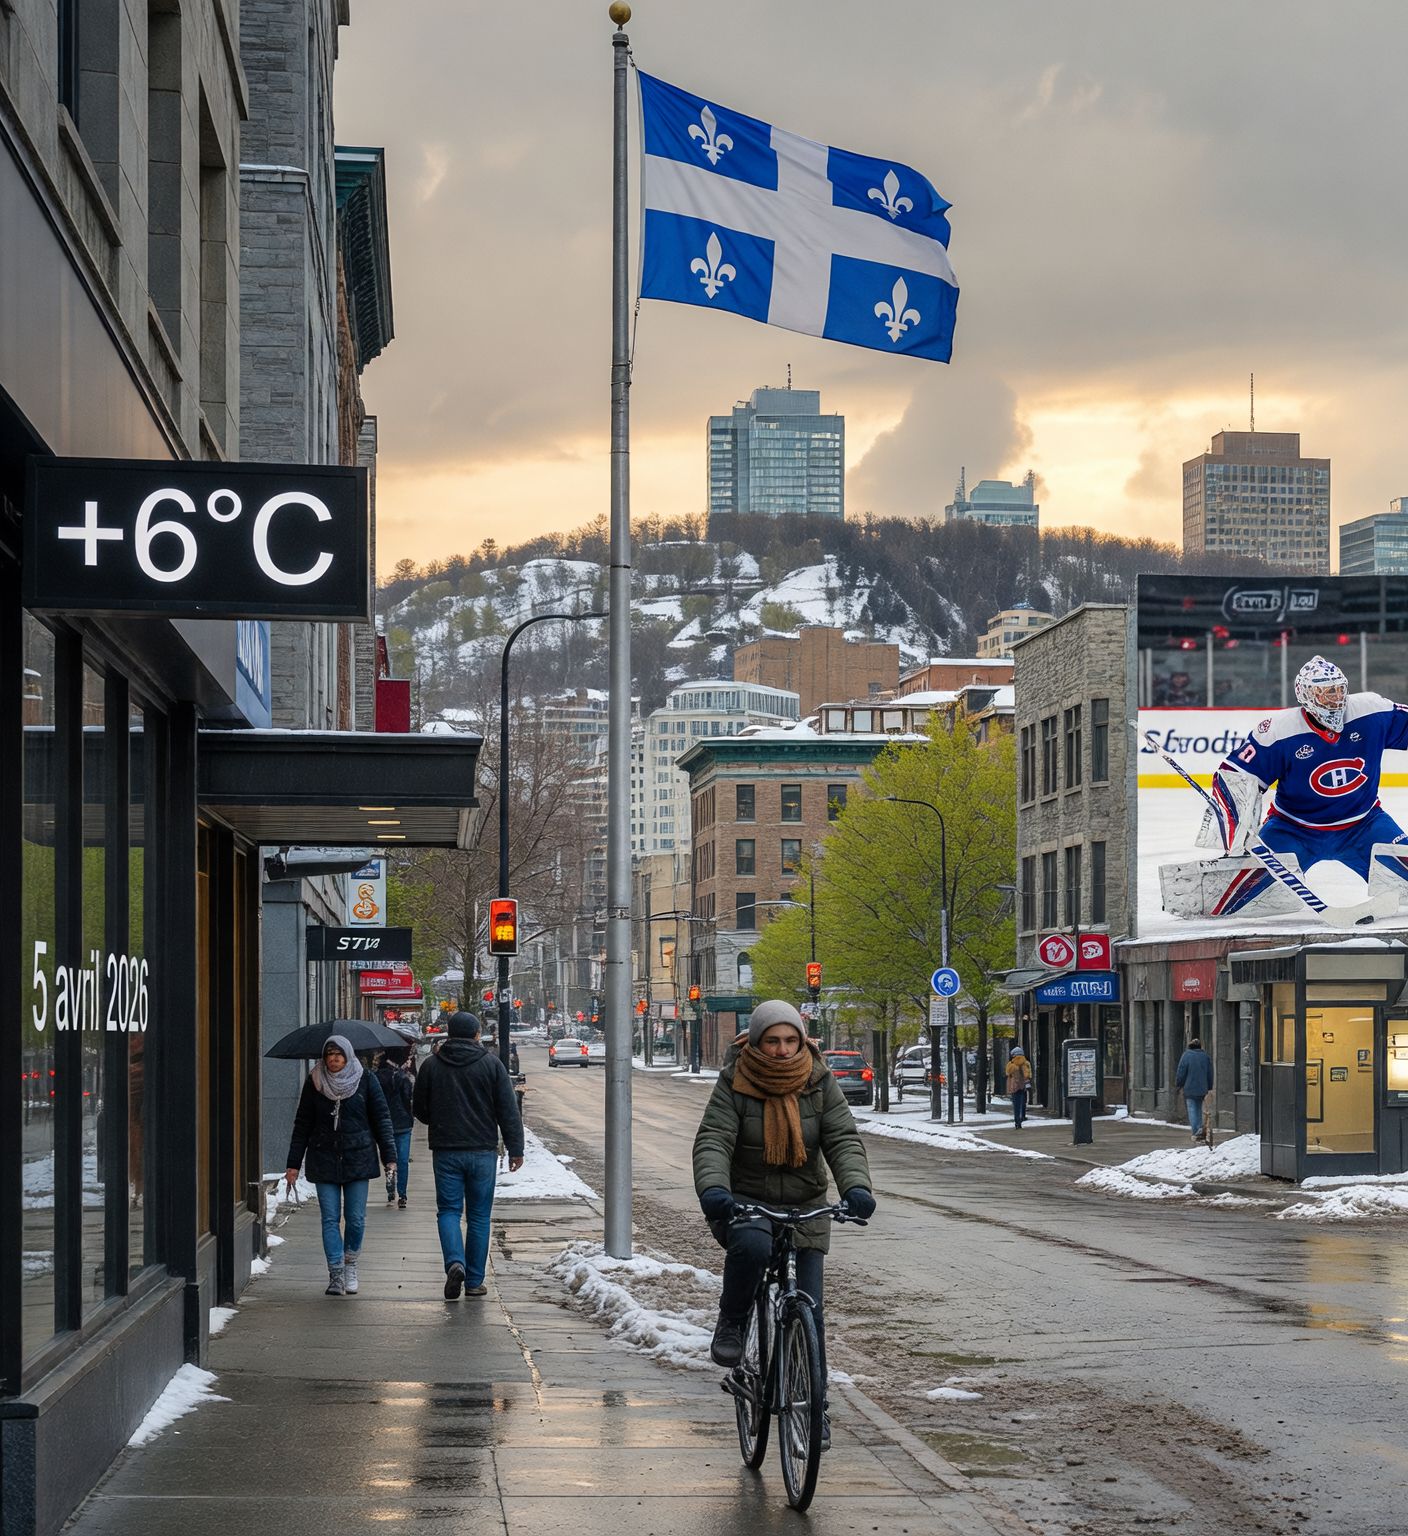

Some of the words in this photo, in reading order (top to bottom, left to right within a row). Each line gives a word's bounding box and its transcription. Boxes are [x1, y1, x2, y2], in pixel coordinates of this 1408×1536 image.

[58, 488, 334, 586] +6°C
[32, 940, 48, 1032] 5
[55, 949, 100, 1032] avril
[106, 952, 149, 1033] 2026
